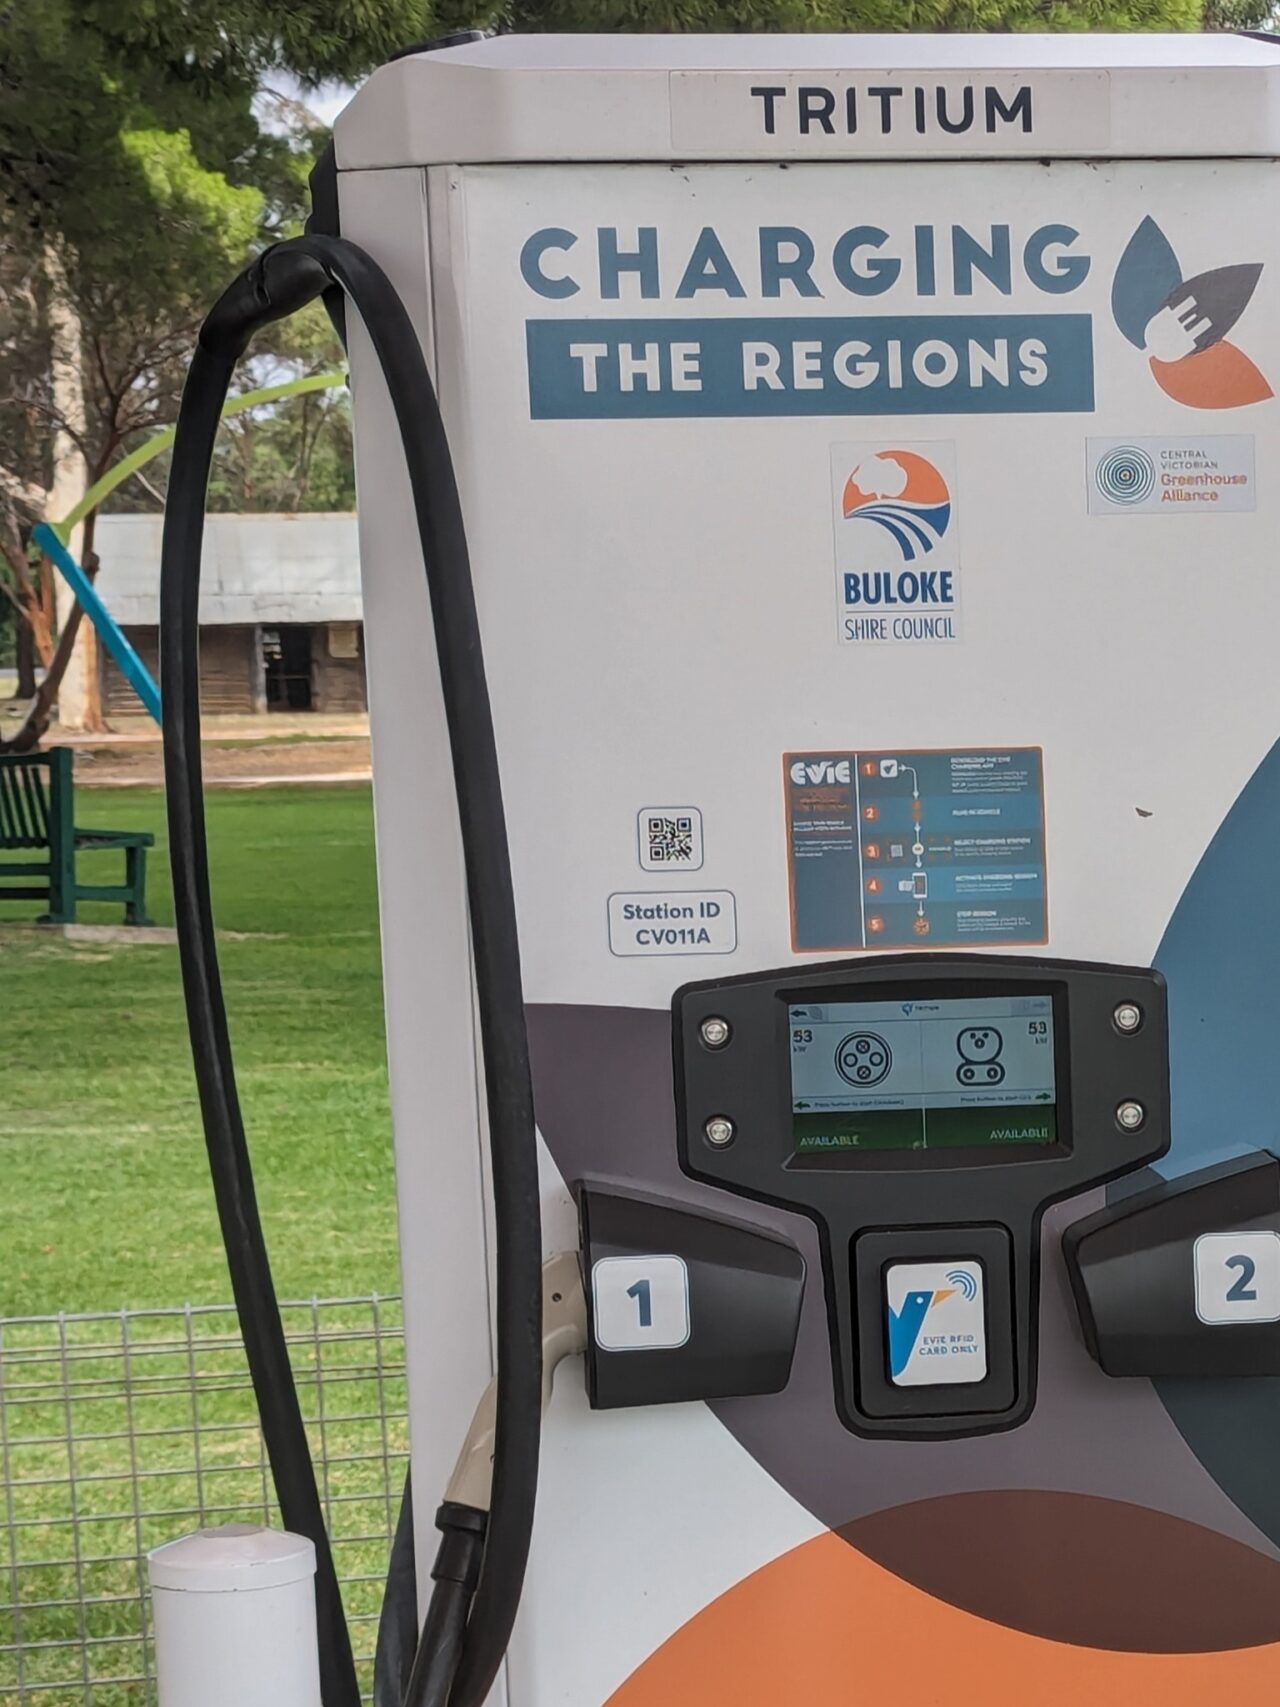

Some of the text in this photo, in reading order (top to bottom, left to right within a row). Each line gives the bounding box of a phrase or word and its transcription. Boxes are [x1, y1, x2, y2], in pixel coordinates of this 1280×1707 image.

[751, 86, 1032, 134] TRITIUM
[520, 224, 1091, 300] CHARGING
[569, 338, 1048, 392] THE REGIONS
[1160, 450, 1208, 459] CENTRAL
[1160, 461, 1219, 470] VICTORIAN
[1161, 473, 1248, 486] Greenhouse
[1161, 490, 1219, 502] Alliance
[844, 571, 954, 604] BULOKE
[845, 617, 956, 640] SHIRE COUNCIL
[623, 902, 721, 920] Station ID
[636, 928, 711, 945] CV011A
[793, 1029, 813, 1043] 53
[800, 1136, 860, 1146] AVAILABLE
[990, 1128, 1048, 1139] AVAILABLE
[1224, 1255, 1257, 1302] 2
[626, 1279, 652, 1327] 1
[923, 1335, 974, 1345] EVIE RFID
[919, 1345, 979, 1356] CARD ONLY
